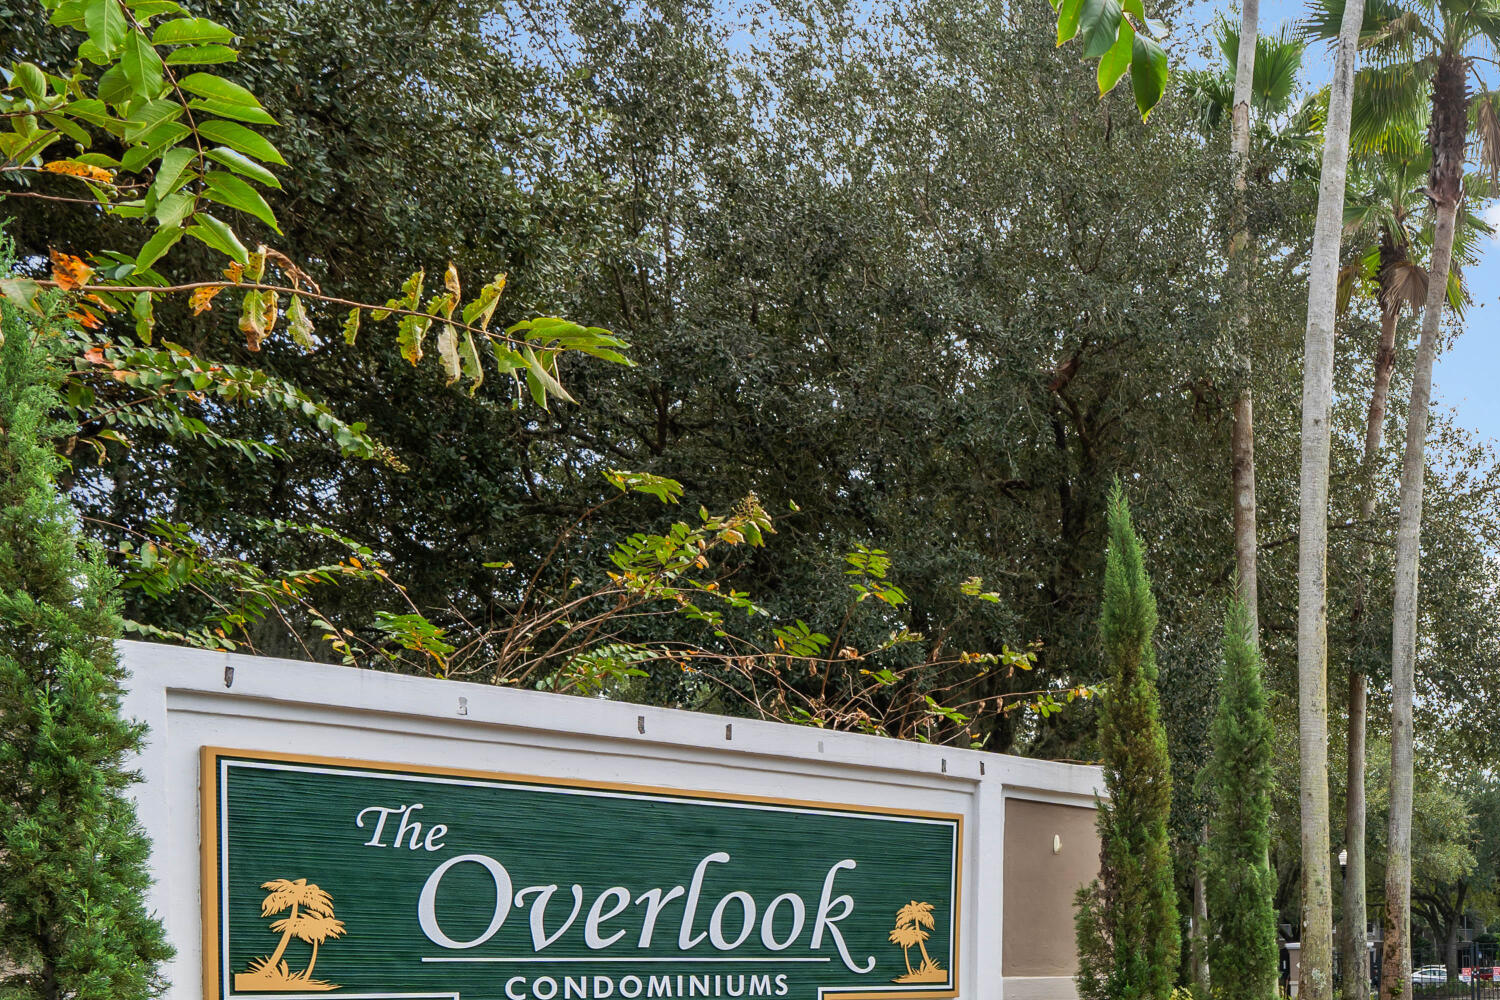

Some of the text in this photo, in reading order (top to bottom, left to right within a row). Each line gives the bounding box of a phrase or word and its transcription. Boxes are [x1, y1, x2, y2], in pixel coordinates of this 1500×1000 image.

[356, 803, 448, 852] The
[418, 851, 876, 974] Overlook
[504, 973, 789, 1000] CONDOMINIUMS
